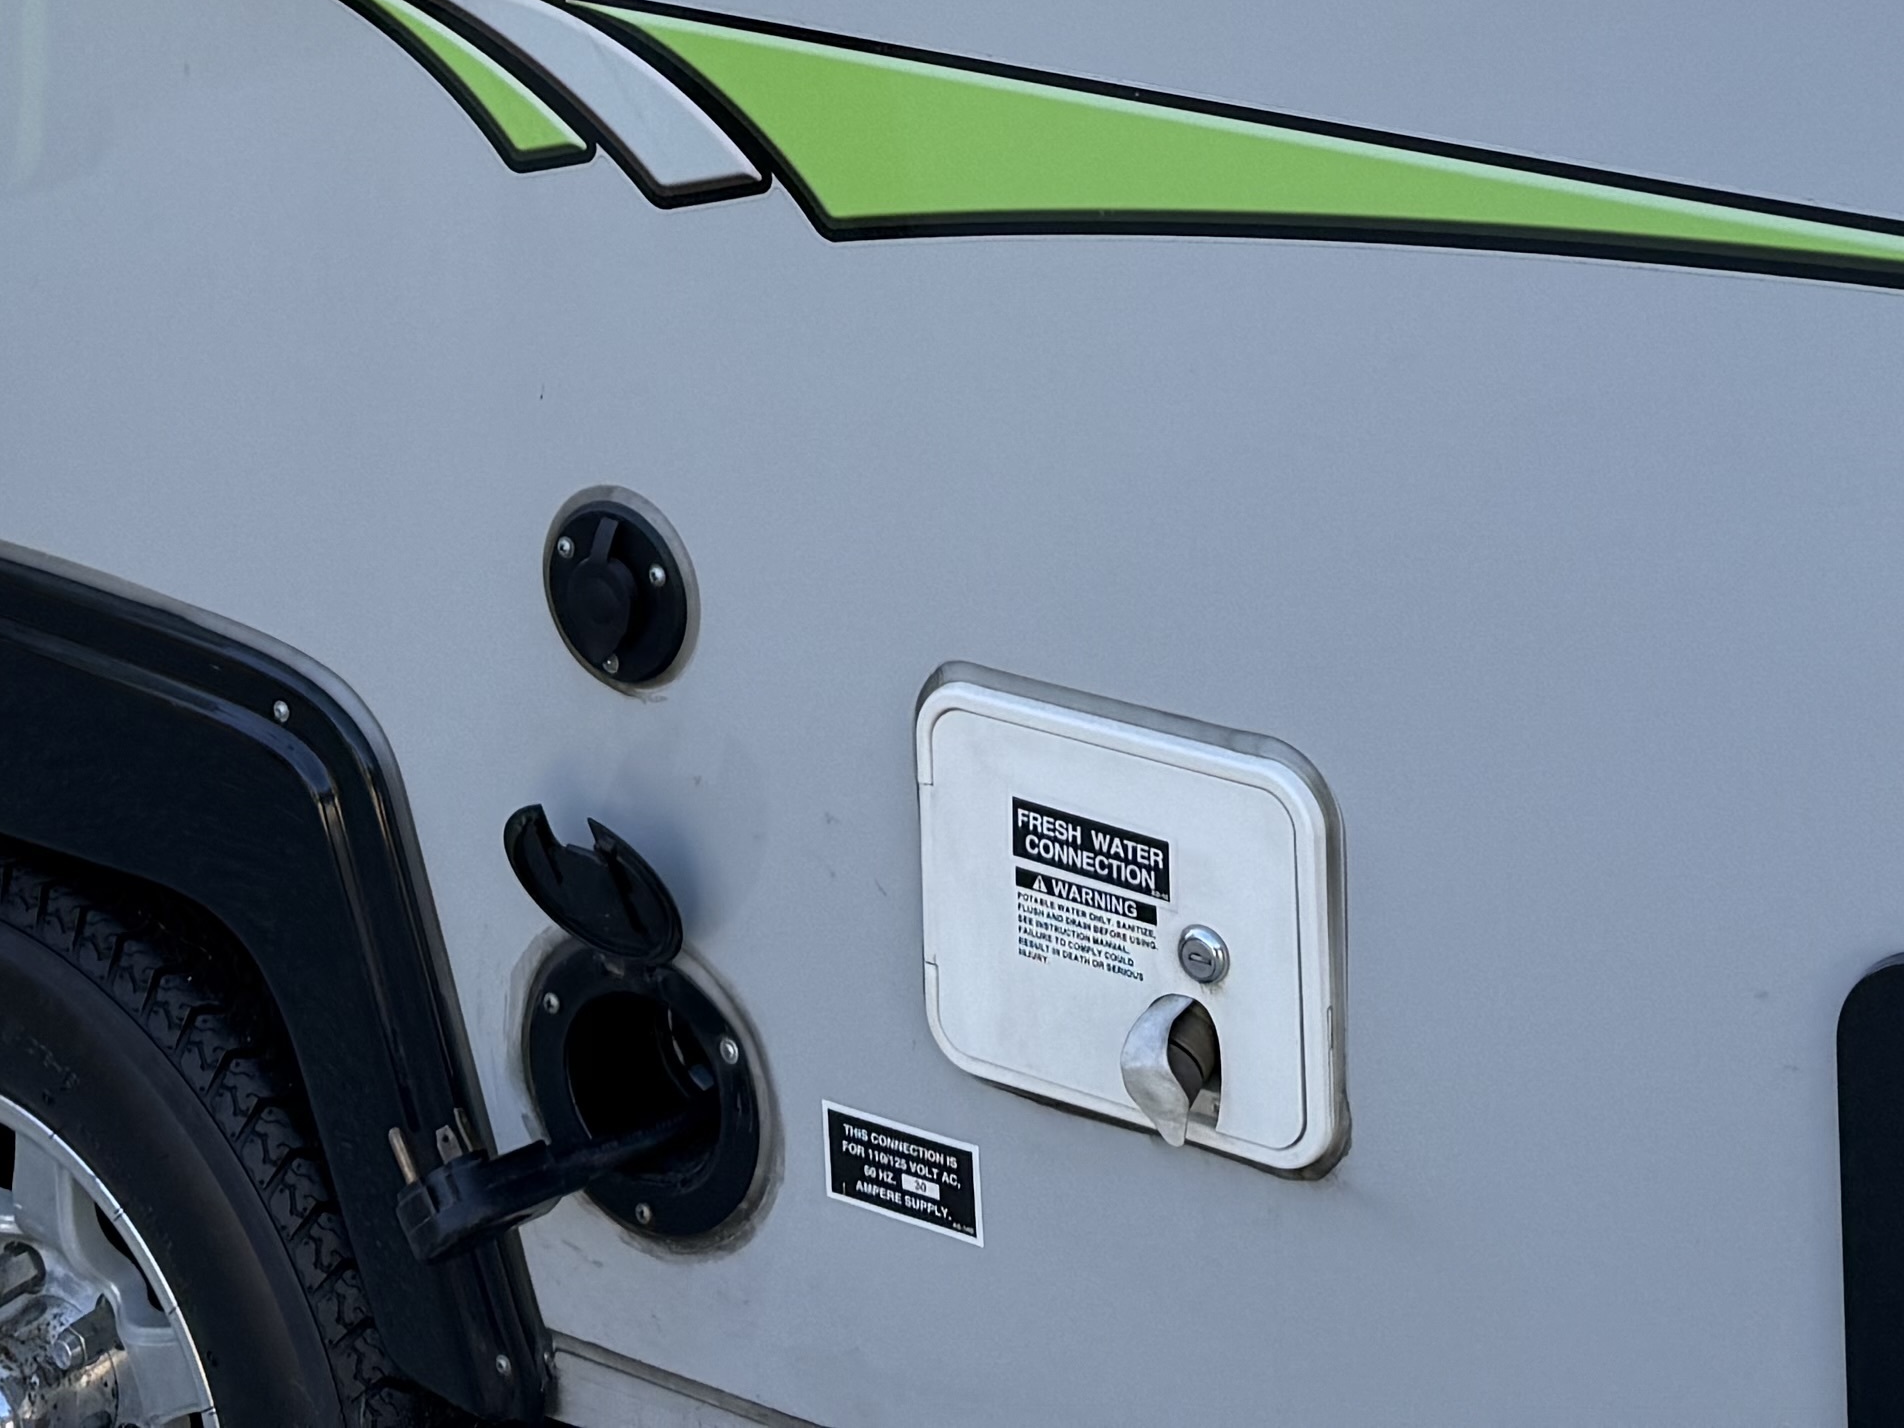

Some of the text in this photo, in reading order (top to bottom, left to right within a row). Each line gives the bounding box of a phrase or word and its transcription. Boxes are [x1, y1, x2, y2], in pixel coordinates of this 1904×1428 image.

[1017, 808, 1164, 869] FRESH WATER
[1025, 834, 1156, 890] CONNECTION
[1018, 891, 1055, 909] POTABLE
[1057, 903, 1087, 918] WATER
[1051, 878, 1138, 918] WARNING
[1018, 902, 1044, 918] FLUSH
[1046, 911, 1064, 923] AND
[1065, 916, 1092, 932] DRAIN
[1093, 925, 1127, 942] BEFORE
[1018, 913, 1033, 925] SEE
[1036, 918, 1091, 943] INSTRUCTION
[1018, 925, 1134, 967] FAILURE TO COMPLY COULD
[1018, 936, 1144, 982] RESULT IN DEATH OR SERIOUS
[842, 1140, 865, 1159] FOR
[909, 1160, 939, 1180] VOLT
[941, 1172, 961, 1190] AC,
[843, 1123, 958, 1169] THIS CONNECTION IS
[864, 1164, 876, 1179] 60
[878, 1168, 897, 1185] HZ.
[856, 1180, 952, 1221] AMPERE SUPPLY.
